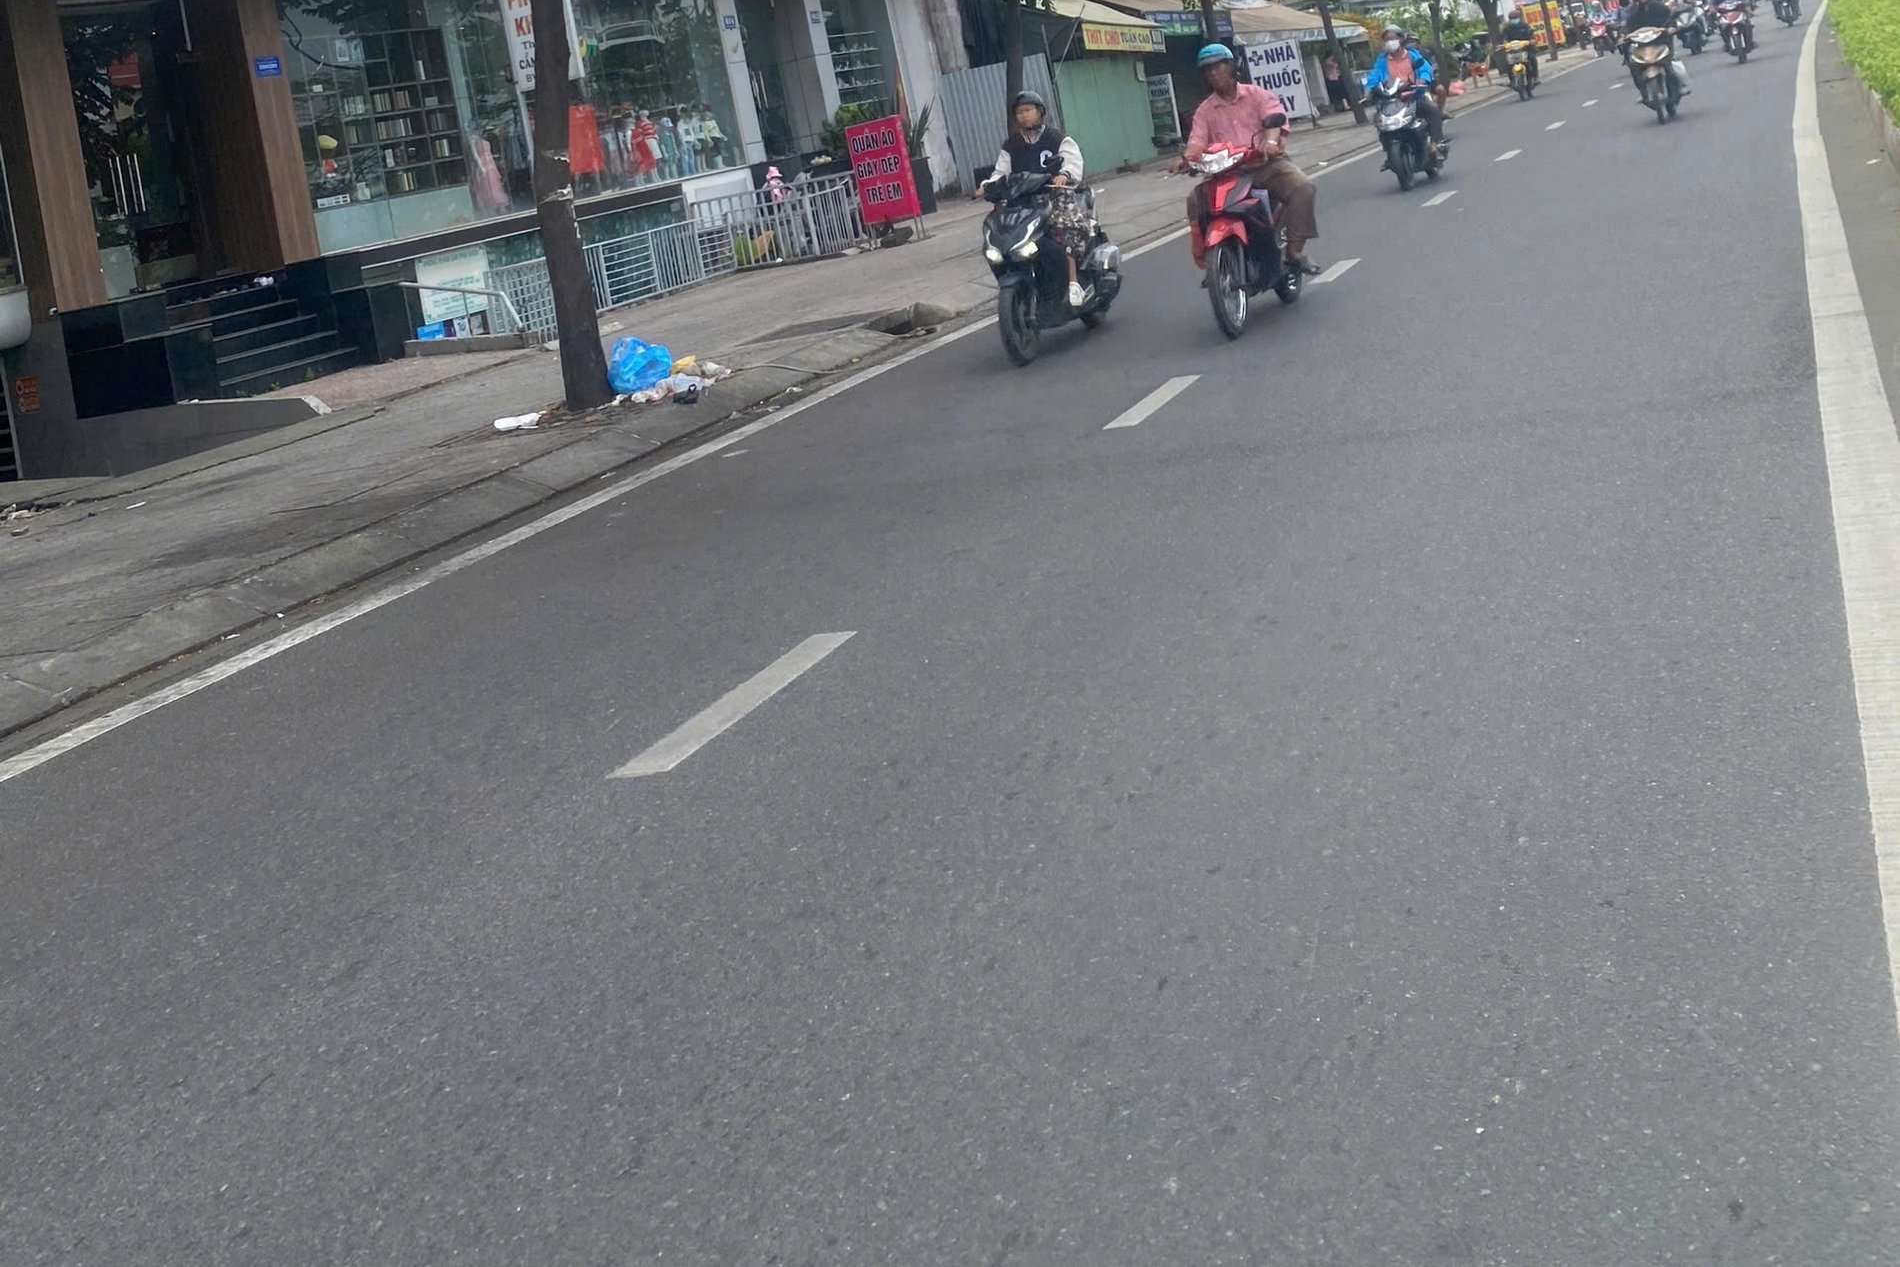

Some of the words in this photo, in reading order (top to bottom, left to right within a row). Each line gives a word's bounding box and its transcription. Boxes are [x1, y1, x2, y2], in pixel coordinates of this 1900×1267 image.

[1264, 41, 1296, 65] NHÀ
[1254, 65, 1301, 90] THUỐC
[886, 181, 903, 201] EM
